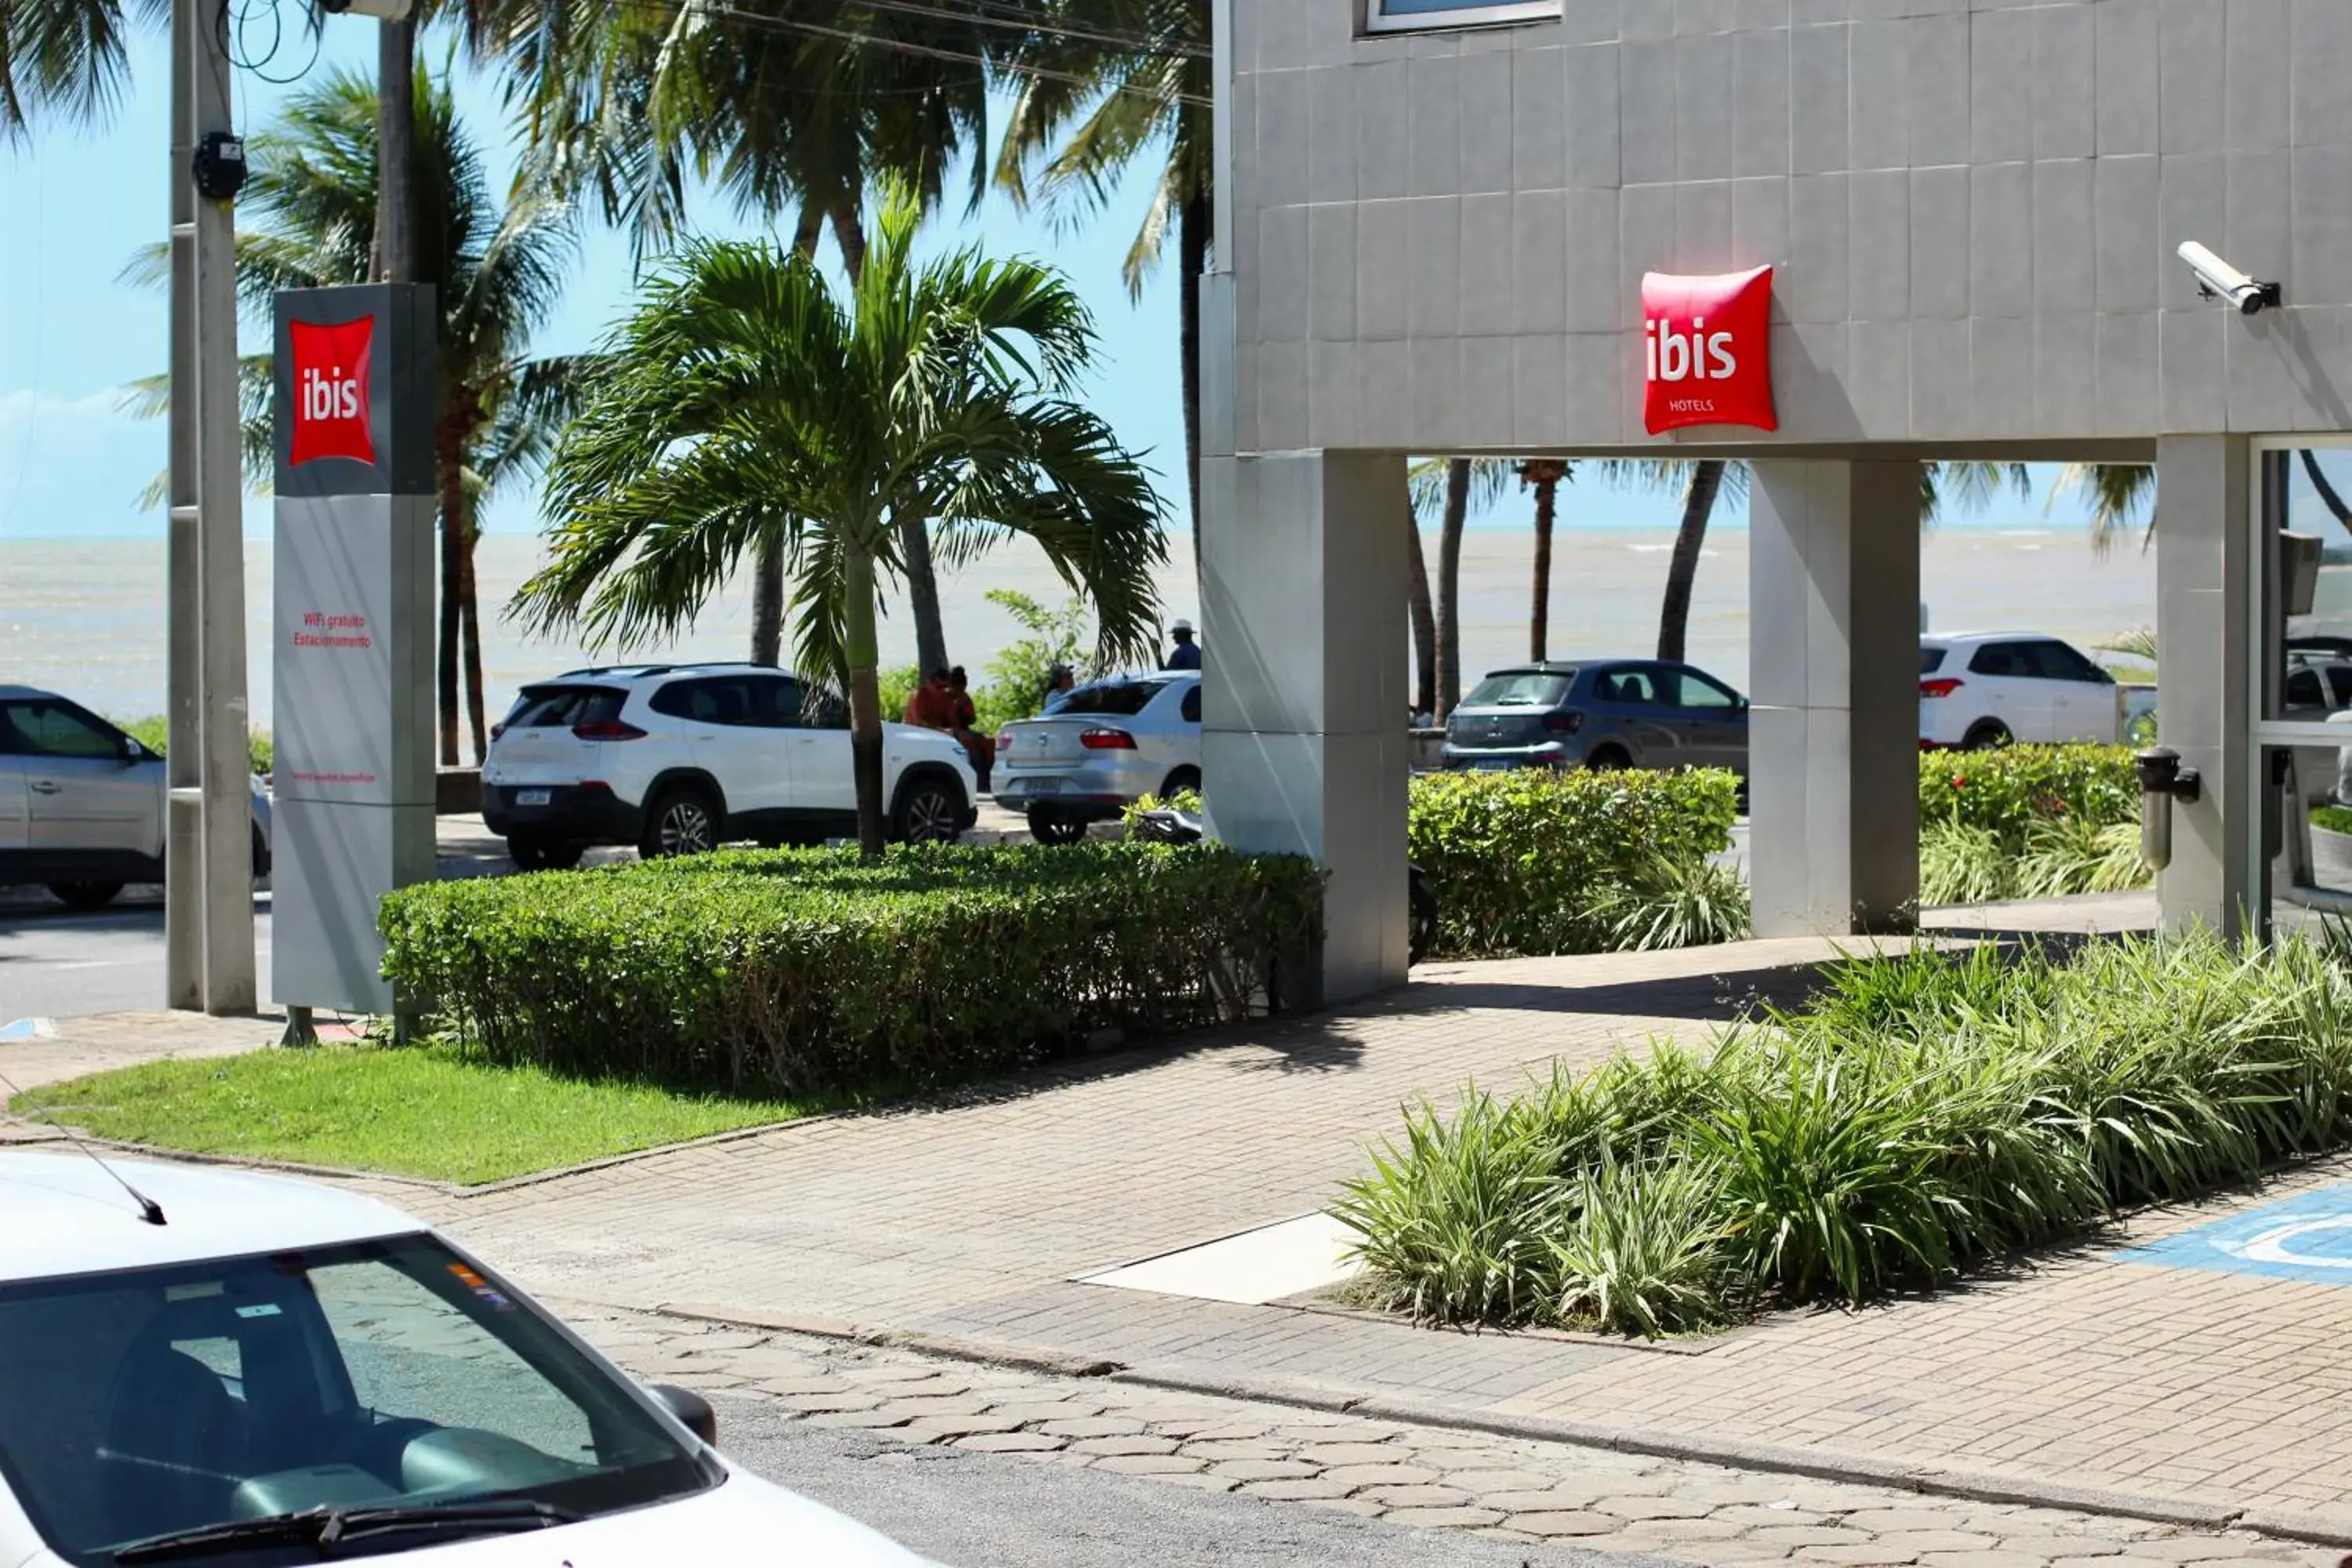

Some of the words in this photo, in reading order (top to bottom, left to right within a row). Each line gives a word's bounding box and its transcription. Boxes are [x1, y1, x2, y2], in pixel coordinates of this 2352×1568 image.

[1646, 316, 1737, 381] ibis
[303, 366, 358, 421] ibis
[1669, 399, 1715, 412] HOTELS
[327, 615, 365, 630] gratuito
[294, 631, 372, 648] Estacionamento
